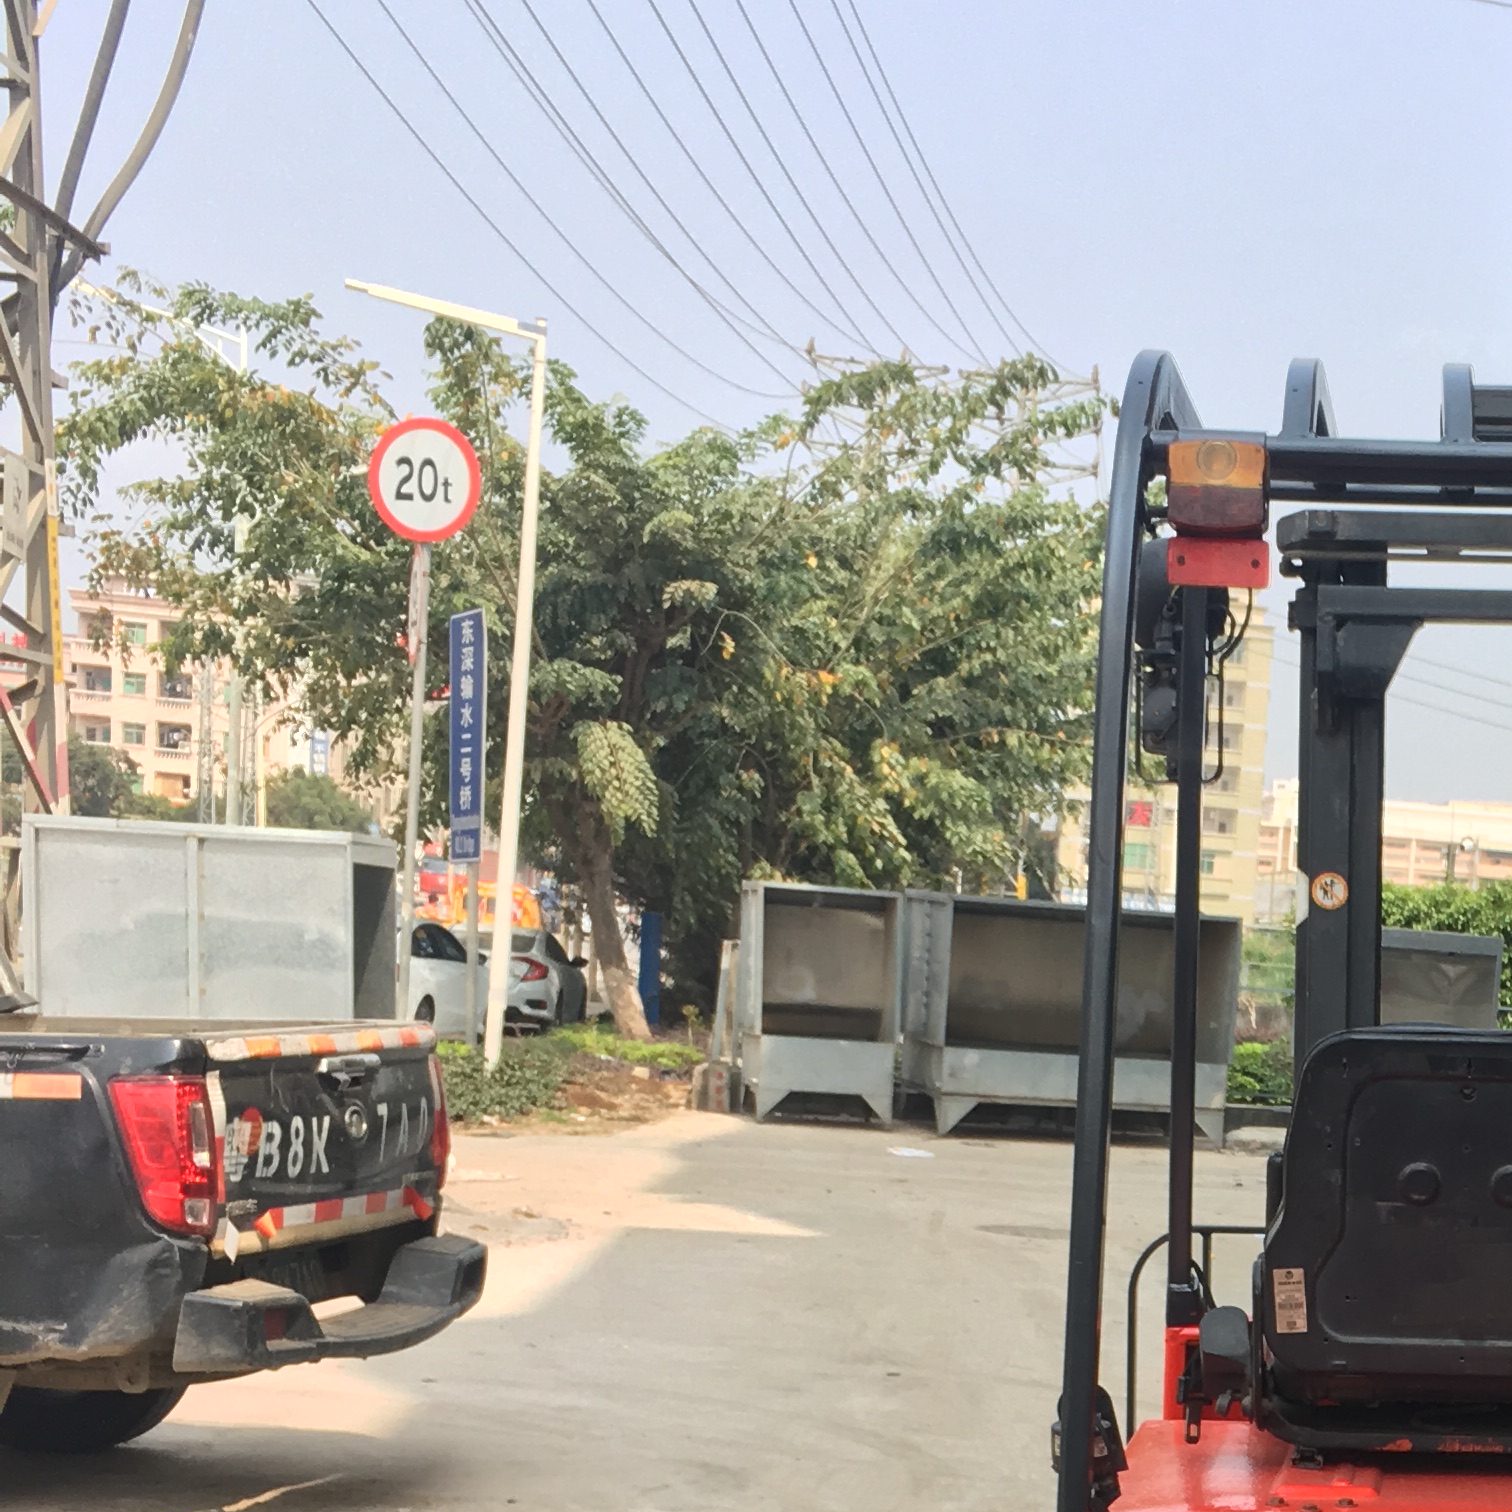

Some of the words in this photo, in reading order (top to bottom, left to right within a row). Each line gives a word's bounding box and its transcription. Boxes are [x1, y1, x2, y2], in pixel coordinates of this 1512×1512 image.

[394, 455, 453, 504] 20t
[459, 618, 475, 811] 东深输水二号桥
